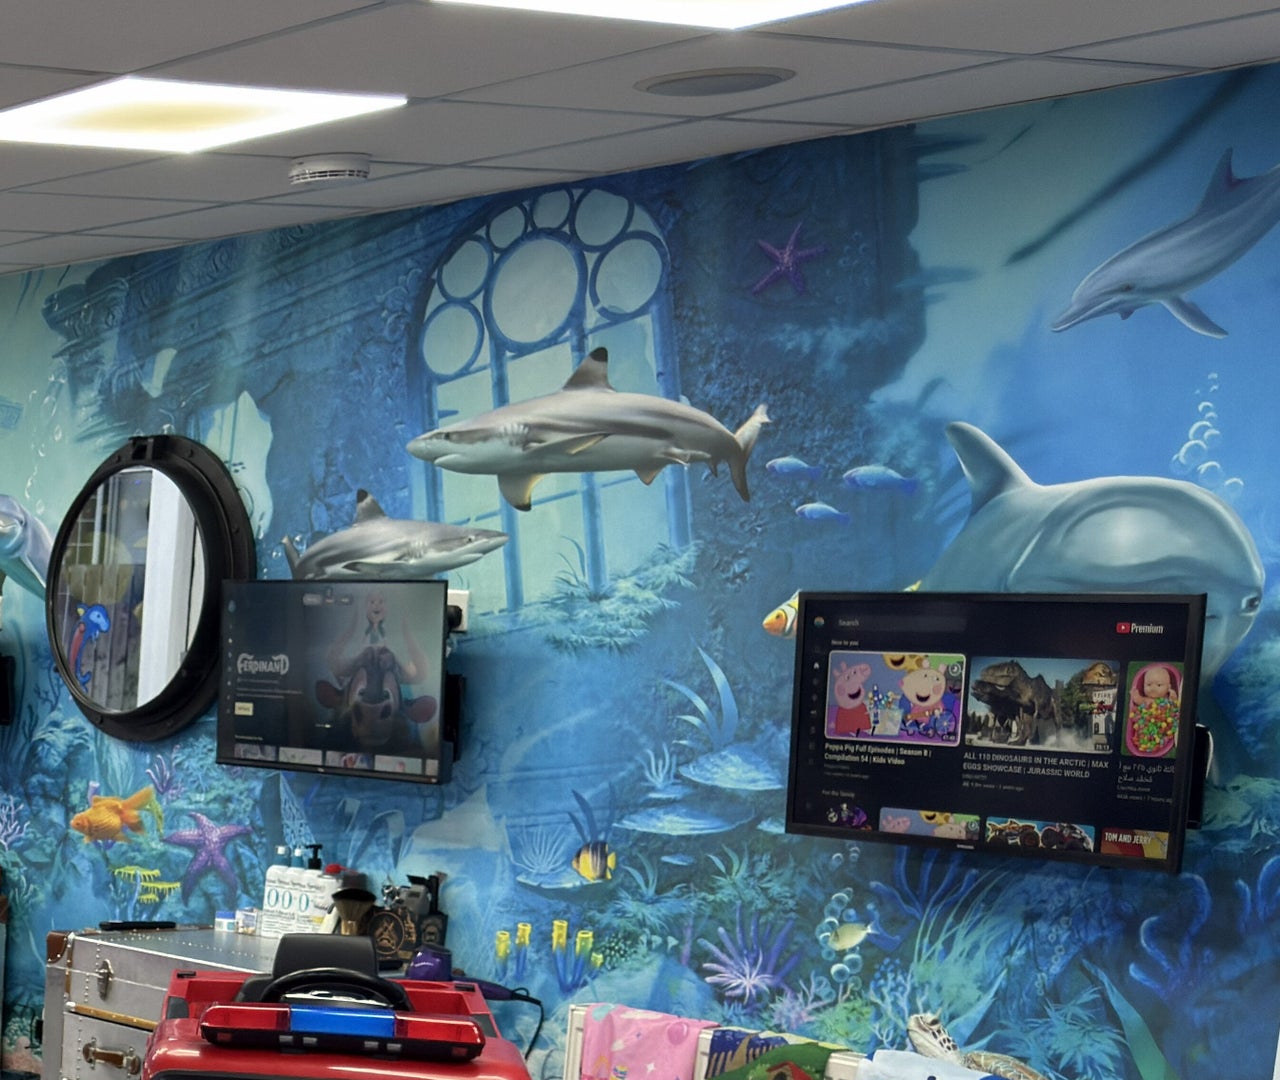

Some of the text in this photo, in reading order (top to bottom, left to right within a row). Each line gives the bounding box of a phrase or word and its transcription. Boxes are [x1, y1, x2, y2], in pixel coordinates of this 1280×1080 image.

[1130, 622, 1165, 635] Premium
[236, 652, 290, 676] FERDINAND
[963, 752, 976, 760] ALL
[991, 754, 1032, 764] DINOSAURS
[1043, 757, 1057, 766] THE
[1058, 758, 1085, 768] ARCTIC
[1091, 761, 1109, 769] MAX
[1027, 768, 1062, 777] JURASSIC
[1064, 770, 1090, 778] WORLD
[1104, 832, 1152, 845] TOM AND JERRY
